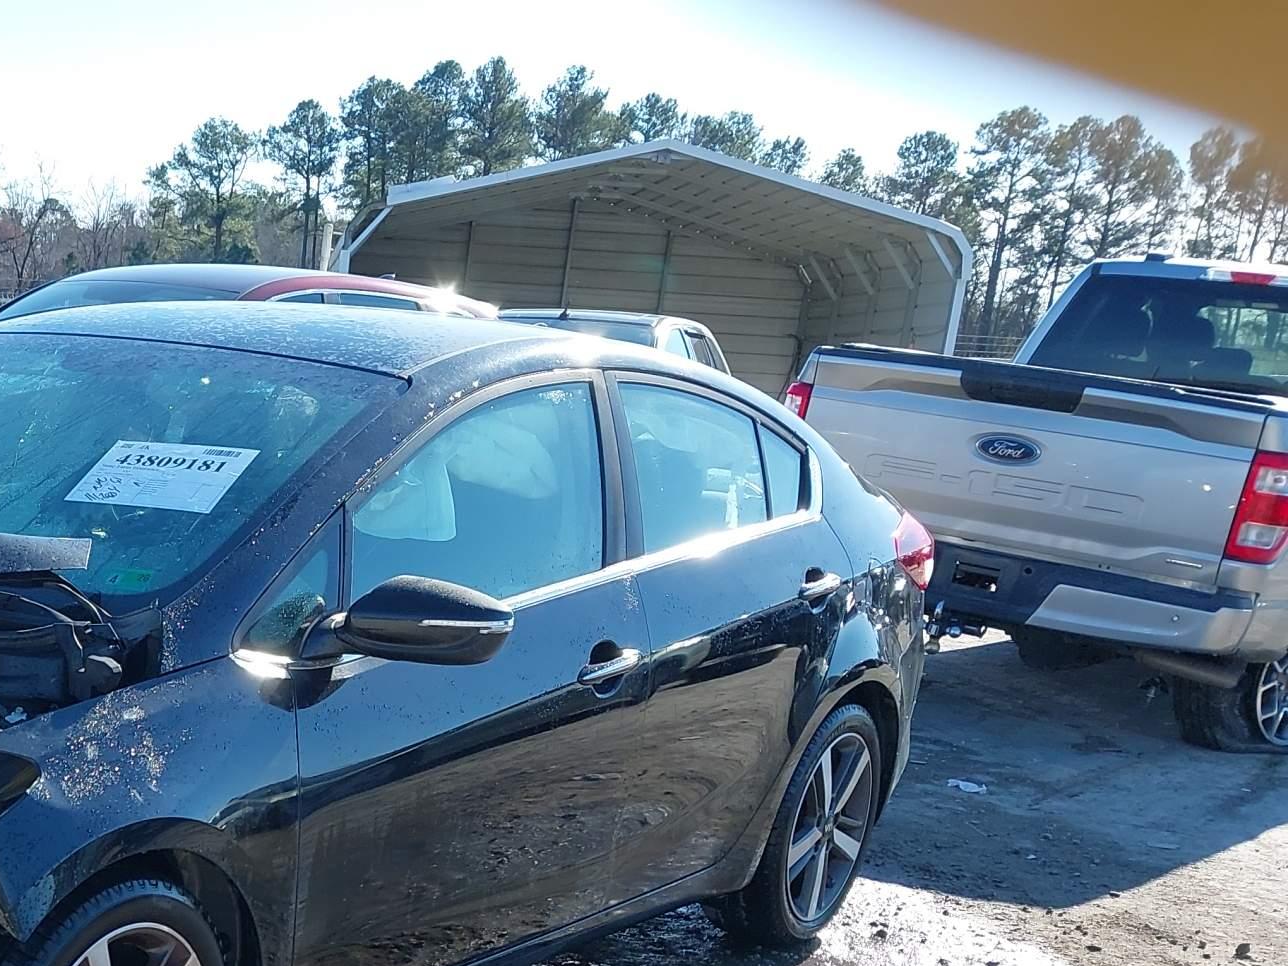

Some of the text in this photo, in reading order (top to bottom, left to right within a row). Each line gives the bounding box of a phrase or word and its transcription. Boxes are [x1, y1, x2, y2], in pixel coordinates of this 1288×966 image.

[988, 440, 1025, 458] Ford
[116, 453, 229, 473] 43809181
[863, 453, 1144, 521] F-150
